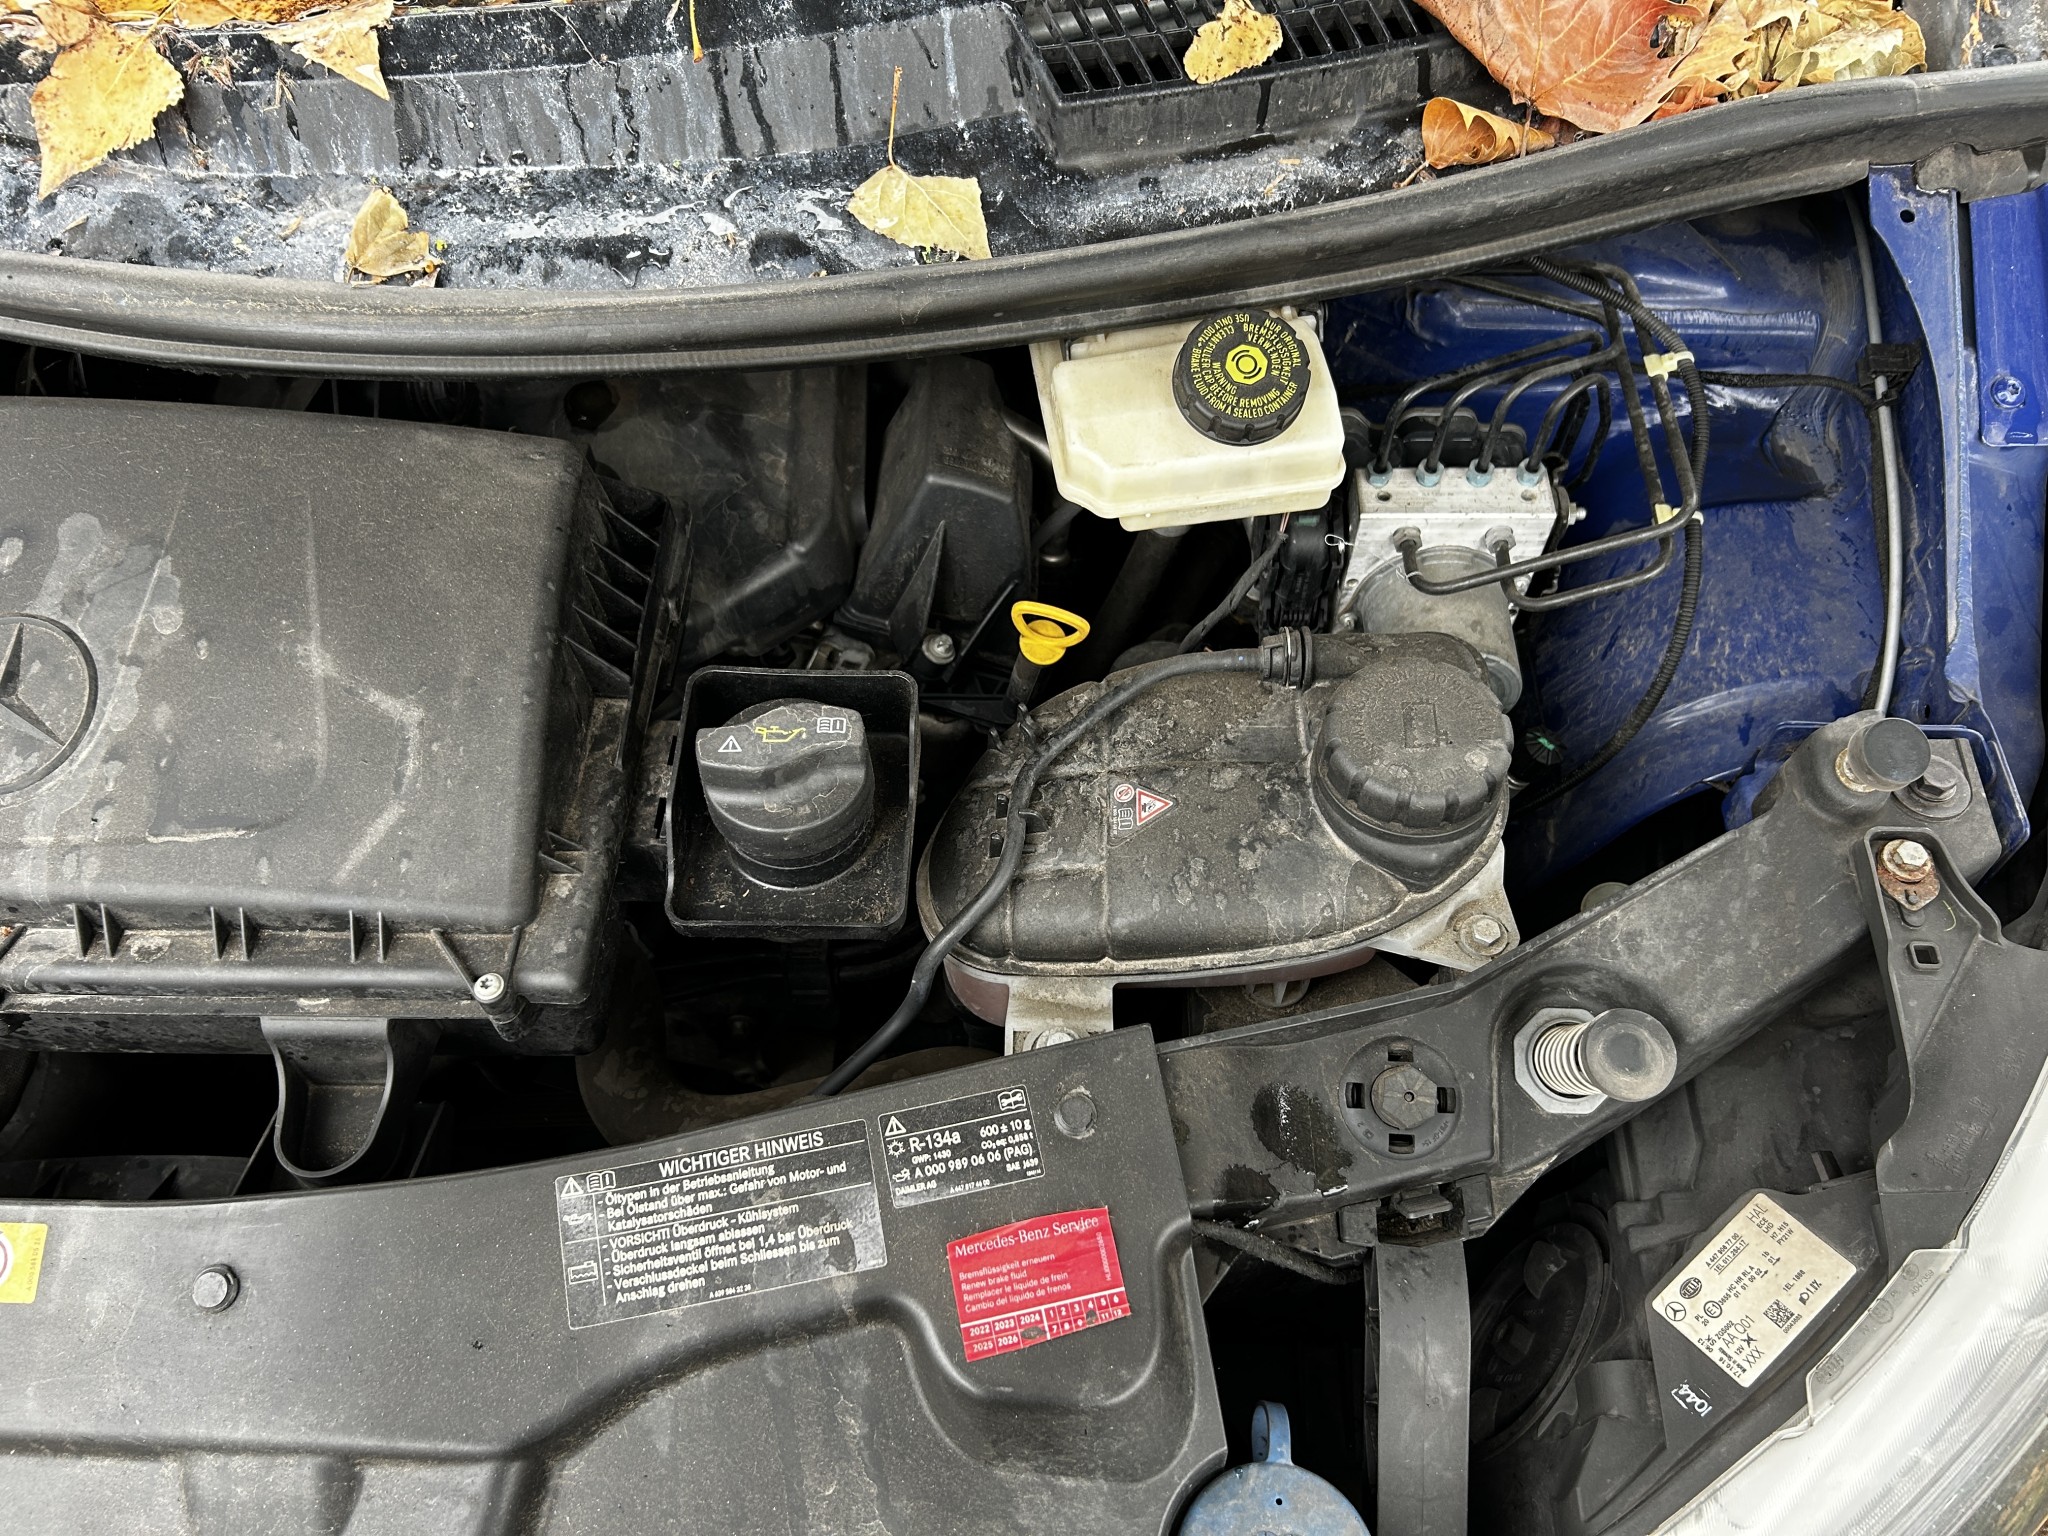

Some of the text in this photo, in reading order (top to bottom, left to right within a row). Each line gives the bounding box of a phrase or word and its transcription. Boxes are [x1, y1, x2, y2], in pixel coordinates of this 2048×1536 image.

[1248, 333, 1281, 376] VERWENDEN
[1264, 319, 1301, 367] NUR ORIGINAL
[1191, 314, 1298, 418] USE ONLY BRAKE FLUID FROM A SEALED CONTAINER
[1212, 362, 1237, 394] WARNING
[1202, 370, 1215, 384] CAP
[1210, 384, 1238, 406] BEFORE
[1240, 388, 1280, 407] REMOVING
[909, 1130, 961, 1152] R-134a
[979, 1123, 999, 1138] 600
[1009, 1118, 1022, 1131] 10
[1023, 1118, 1031, 1130] g
[659, 1131, 823, 1177] WICHTIGER HINWEIS
[914, 1143, 1033, 1179] A 000 989 06 06 (PAG)
[605, 1164, 775, 1205] Öltypen in der Betriebsanleitung
[606, 1205, 624, 1219] Bei
[626, 1196, 668, 1215] Ölstand
[670, 1193, 695, 1206] über
[729, 1179, 765, 1194] Gefahr
[766, 1175, 787, 1187] von
[788, 1168, 824, 1182] Motor-
[826, 1160, 847, 1175] und
[894, 1182, 926, 1196] DAIMLER
[607, 1204, 712, 1235] Katalysatorschäden
[672, 1216, 728, 1237] Überdruck
[737, 1204, 799, 1224] Kühlsystem
[1745, 1203, 1769, 1223] HAL
[1756, 1216, 1768, 1229] ECE
[1762, 1222, 1774, 1234] LHD
[611, 1224, 765, 1263] Überdruck langsam ablassen
[613, 1217, 854, 1276] Sicherheitsventil öffnet bei 1,4 bar Überdruck
[955, 1217, 1098, 1256] Mercedes-Benz Service
[1724, 1238, 1733, 1246] 77
[1776, 1227, 1794, 1245] PY21W
[614, 1236, 840, 1289] Verschlussdeckel beim Schliessen bis zum
[959, 1253, 1055, 1280] Bremsflüssigkeit erneuern
[1713, 1263, 1724, 1272] 1EL
[615, 1277, 705, 1304] Anschlag drehen
[961, 1269, 1027, 1291] Renew brake fluid
[963, 1287, 1002, 1301] Remplacer
[1013, 1279, 1038, 1290] liquide
[1039, 1276, 1049, 1284] de
[1050, 1272, 1068, 1281] frein
[1681, 1277, 1702, 1298] HELLA
[1726, 1283, 1736, 1293] HC
[1733, 1275, 1744, 1285] HR
[1741, 1269, 1751, 1278] RL
[965, 1301, 994, 1313] Cambio
[995, 1296, 1008, 1305] del
[1035, 1288, 1045, 1296] de
[1046, 1282, 1071, 1293] frenos
[1694, 1303, 1718, 1322] PL E1
[969, 1294, 1119, 1336] 2022 2023 2024 1 2 3 4 5 6
[973, 1340, 993, 1352] 2025
[997, 1335, 1018, 1346] 2026
[1052, 1324, 1057, 1333] 7
[1063, 1322, 1070, 1330] 8
[1113, 1308, 1123, 1318] 12
[1704, 1334, 1717, 1346] SK
[1721, 1332, 1739, 1349] AA
[1742, 1345, 1765, 1368] XXX
